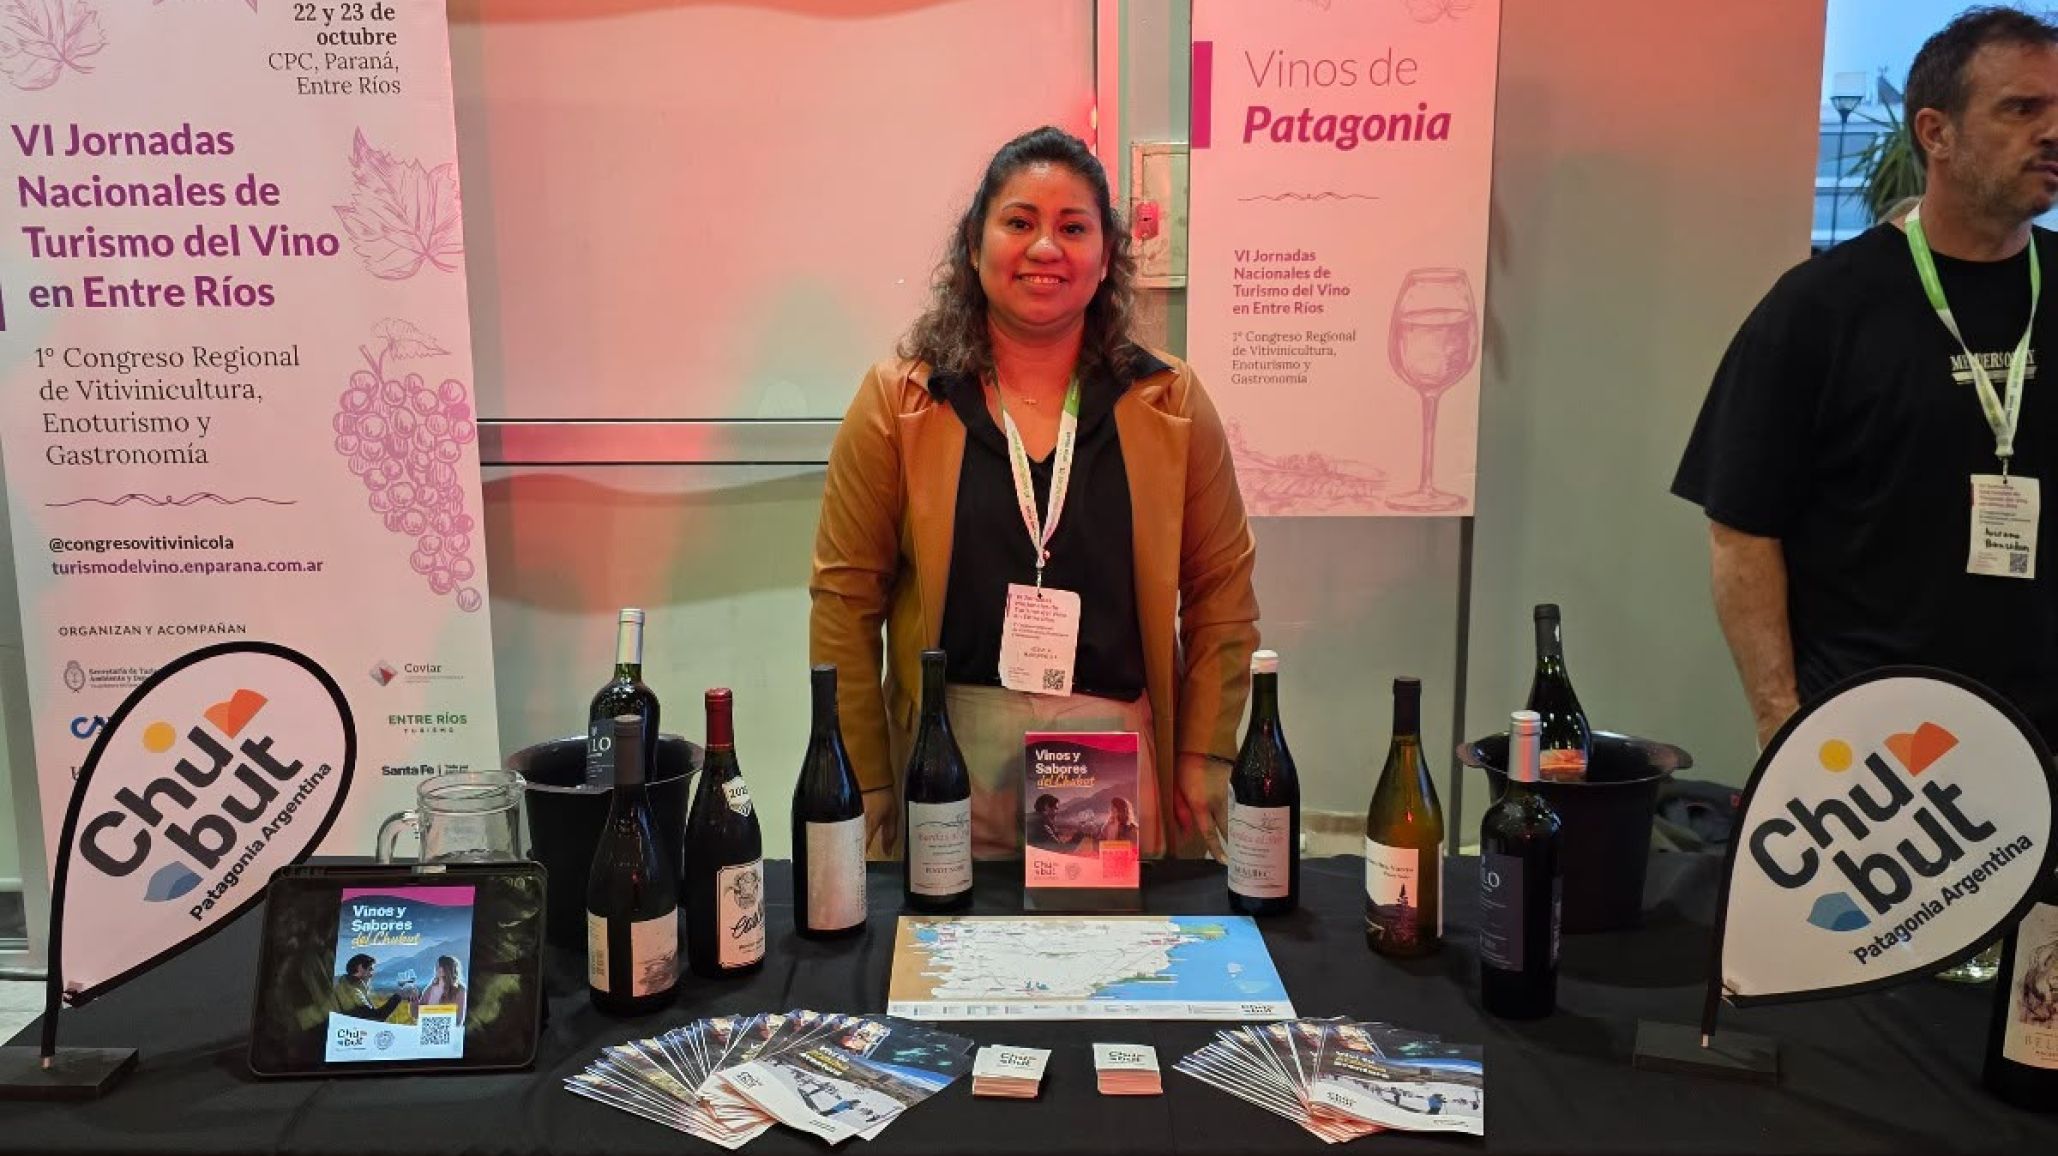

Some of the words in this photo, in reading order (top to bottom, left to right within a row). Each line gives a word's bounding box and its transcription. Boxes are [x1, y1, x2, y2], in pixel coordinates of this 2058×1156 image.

[294, 2, 317, 22] 22
[322, 7, 335, 27] y
[341, 2, 365, 22] 23
[370, 1, 396, 22] de
[316, 26, 397, 46] octubre
[268, 52, 318, 74] CPC,
[324, 50, 399, 74] Paraná,
[1244, 49, 1358, 89] Vinos
[1368, 47, 1418, 88] de
[298, 77, 352, 96] Entre
[358, 76, 401, 96] Ríos
[1242, 102, 1452, 152] Patagonia
[11, 124, 55, 157] VI
[65, 123, 236, 157] Jornadas
[17, 173, 227, 208] Nacionales
[234, 173, 281, 207] de
[22, 225, 175, 259] Turismo
[183, 225, 240, 258] del
[248, 225, 341, 257] Vino
[1234, 250, 1251, 262] VI
[1252, 249, 1316, 263] Jornadas
[1233, 267, 1311, 280] Nacionales
[1313, 266, 1332, 280] de
[28, 283, 75, 308] en
[82, 276, 187, 308] Entre
[194, 275, 276, 308] Ríos
[1233, 285, 1289, 298] Turismo
[1292, 284, 1314, 297] del
[1316, 284, 1350, 297] Vino
[1232, 304, 1250, 315] en
[1252, 302, 1291, 315] Entre
[1293, 300, 1325, 315] Ríos
[1245, 331, 1303, 346] Congreso
[1305, 329, 1357, 345] Regional
[63, 346, 185, 374] Congreso
[192, 344, 300, 373] Regional
[1232, 344, 1247, 356] de
[1250, 343, 1337, 358] Vitivinicultura,
[1232, 358, 1301, 371] Enoturismo
[1302, 361, 1312, 373] y
[1231, 372, 1308, 385] Gastronomía
[39, 379, 70, 402] de
[75, 377, 263, 404] Vitivinicultura,
[43, 412, 190, 435] Enoturismo
[197, 414, 212, 438] y
[46, 442, 210, 466] Gastronomía
[48, 535, 235, 554] @congresovitivinicola
[52, 558, 324, 577] turismodelvino.enparana.com.ar
[58, 625, 142, 637] ORGANIZAN
[145, 625, 153, 636] Y
[157, 622, 247, 636] ACOMPAÑAN
[404, 663, 442, 673] Coviar
[388, 715, 433, 725] ENTRE
[436, 711, 468, 725] RÍOS
[1035, 749, 1070, 761] Vinos
[1073, 751, 1082, 762] y
[382, 765, 418, 776] Santa
[420, 764, 435, 776] Fe
[1035, 762, 1088, 775] Sabores
[79, 724, 235, 878] Chu
[164, 734, 304, 871] but
[1749, 752, 1915, 889] Chu
[189, 838, 266, 922] Patagonia
[259, 762, 333, 843] Argentina
[1832, 780, 1998, 916] but
[1853, 897, 1944, 965] Patagonia
[1940, 833, 2033, 906] Argentina
[352, 905, 395, 917] Vinos
[396, 905, 407, 919] y
[351, 919, 412, 932] Sabores
